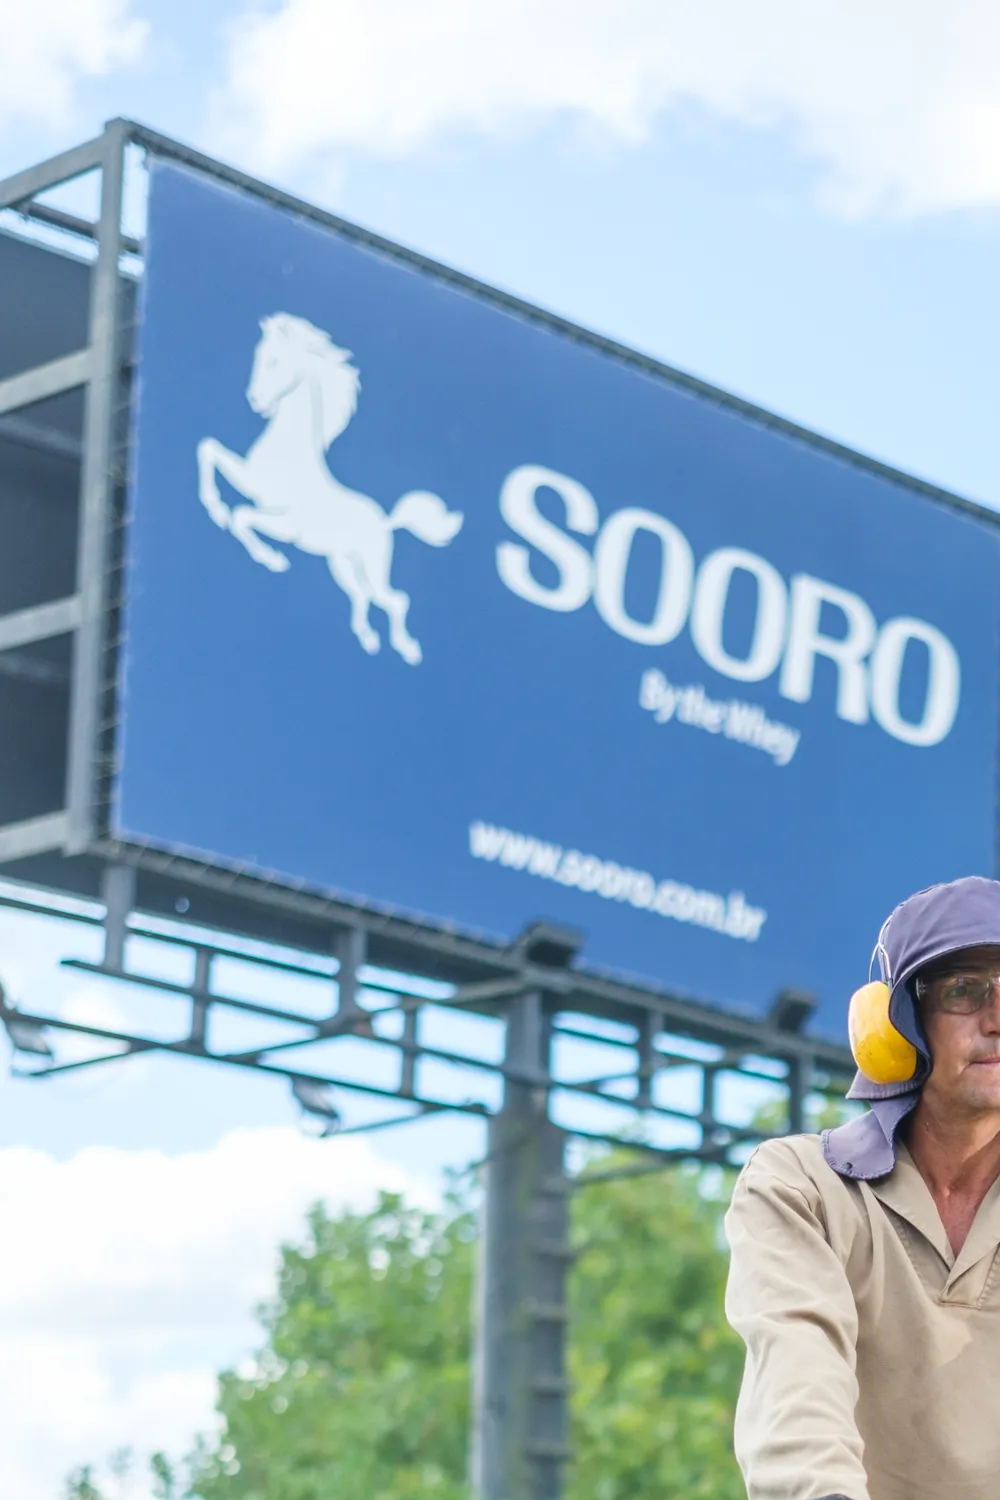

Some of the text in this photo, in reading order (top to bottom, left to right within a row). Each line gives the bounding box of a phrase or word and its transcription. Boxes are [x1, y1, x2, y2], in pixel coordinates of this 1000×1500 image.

[496, 464, 960, 747] SOORO
[639, 668, 676, 723] By
[676, 683, 722, 734] the
[469, 821, 767, 942] www.sooro.com.br
